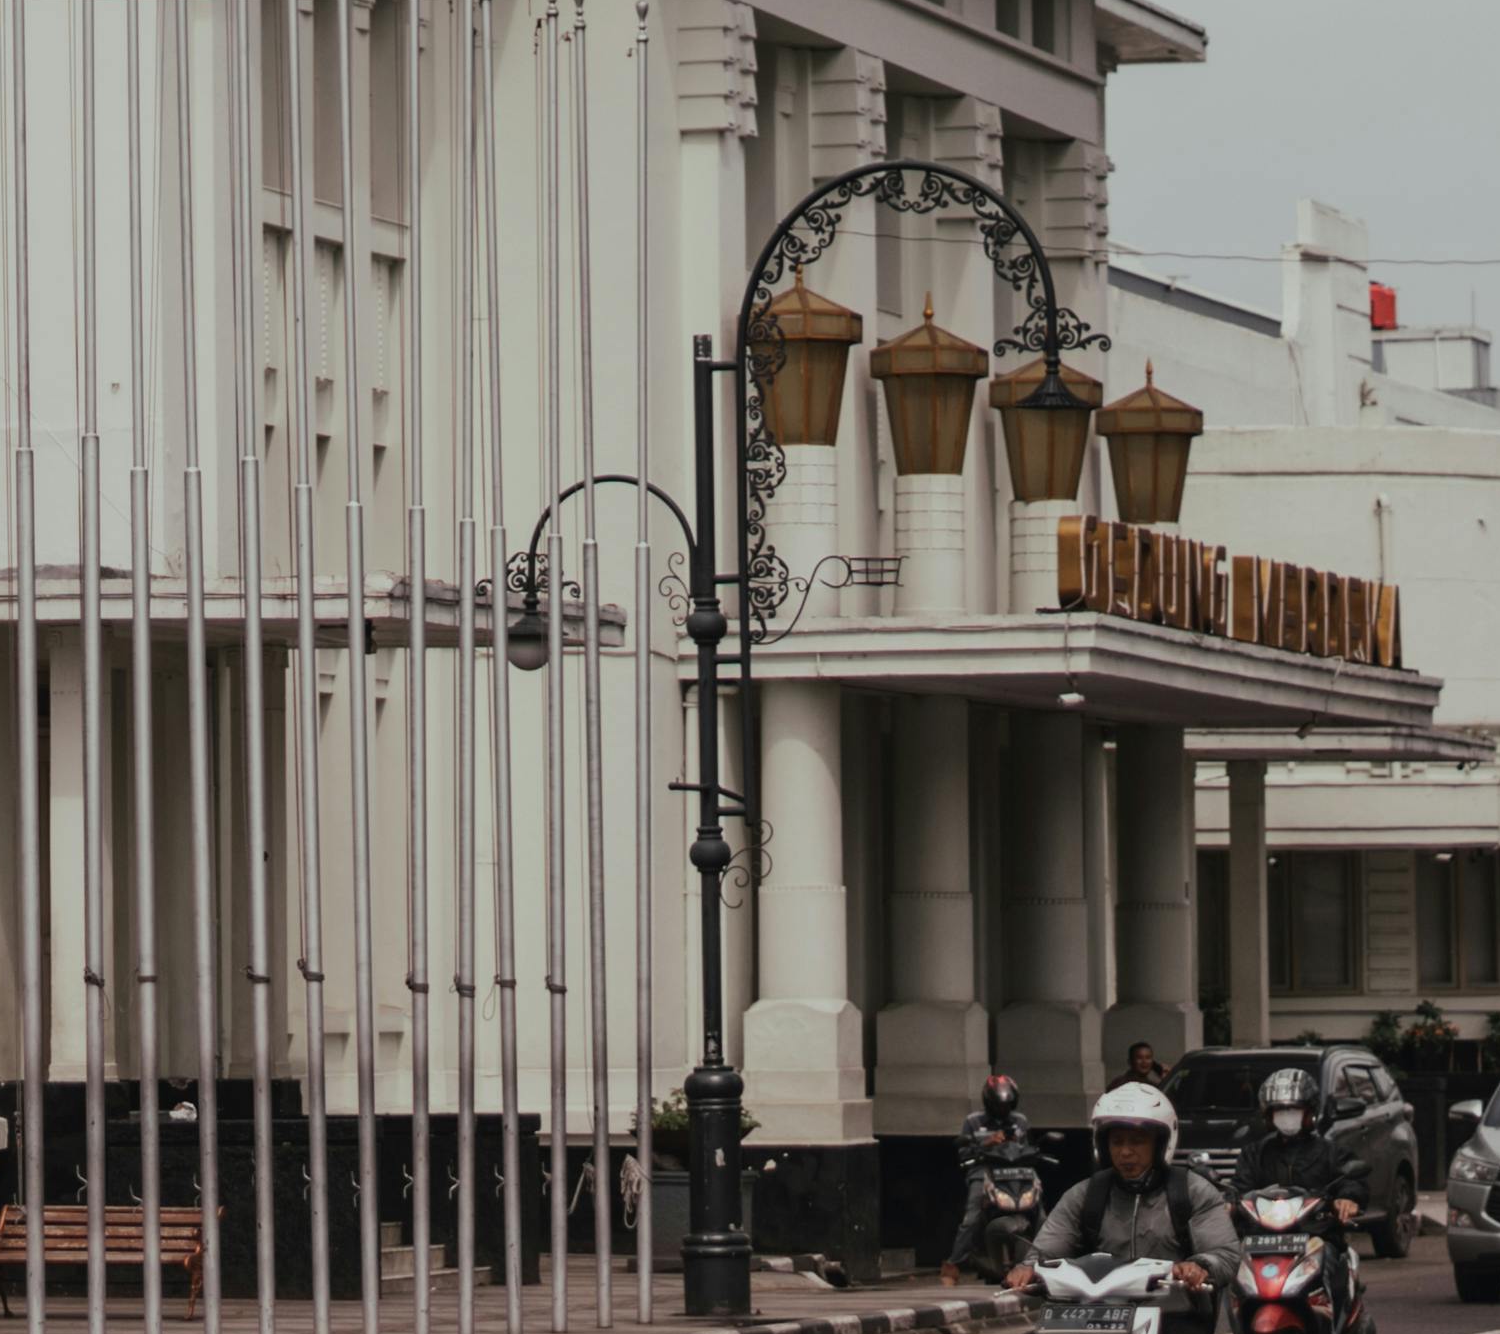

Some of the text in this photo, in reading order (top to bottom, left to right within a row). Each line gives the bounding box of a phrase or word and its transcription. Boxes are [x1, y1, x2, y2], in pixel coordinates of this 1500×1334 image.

[1057, 515, 1402, 668] GEDUNG MERDEKA
[1044, 1308, 1130, 1320] D 4427 ABF
